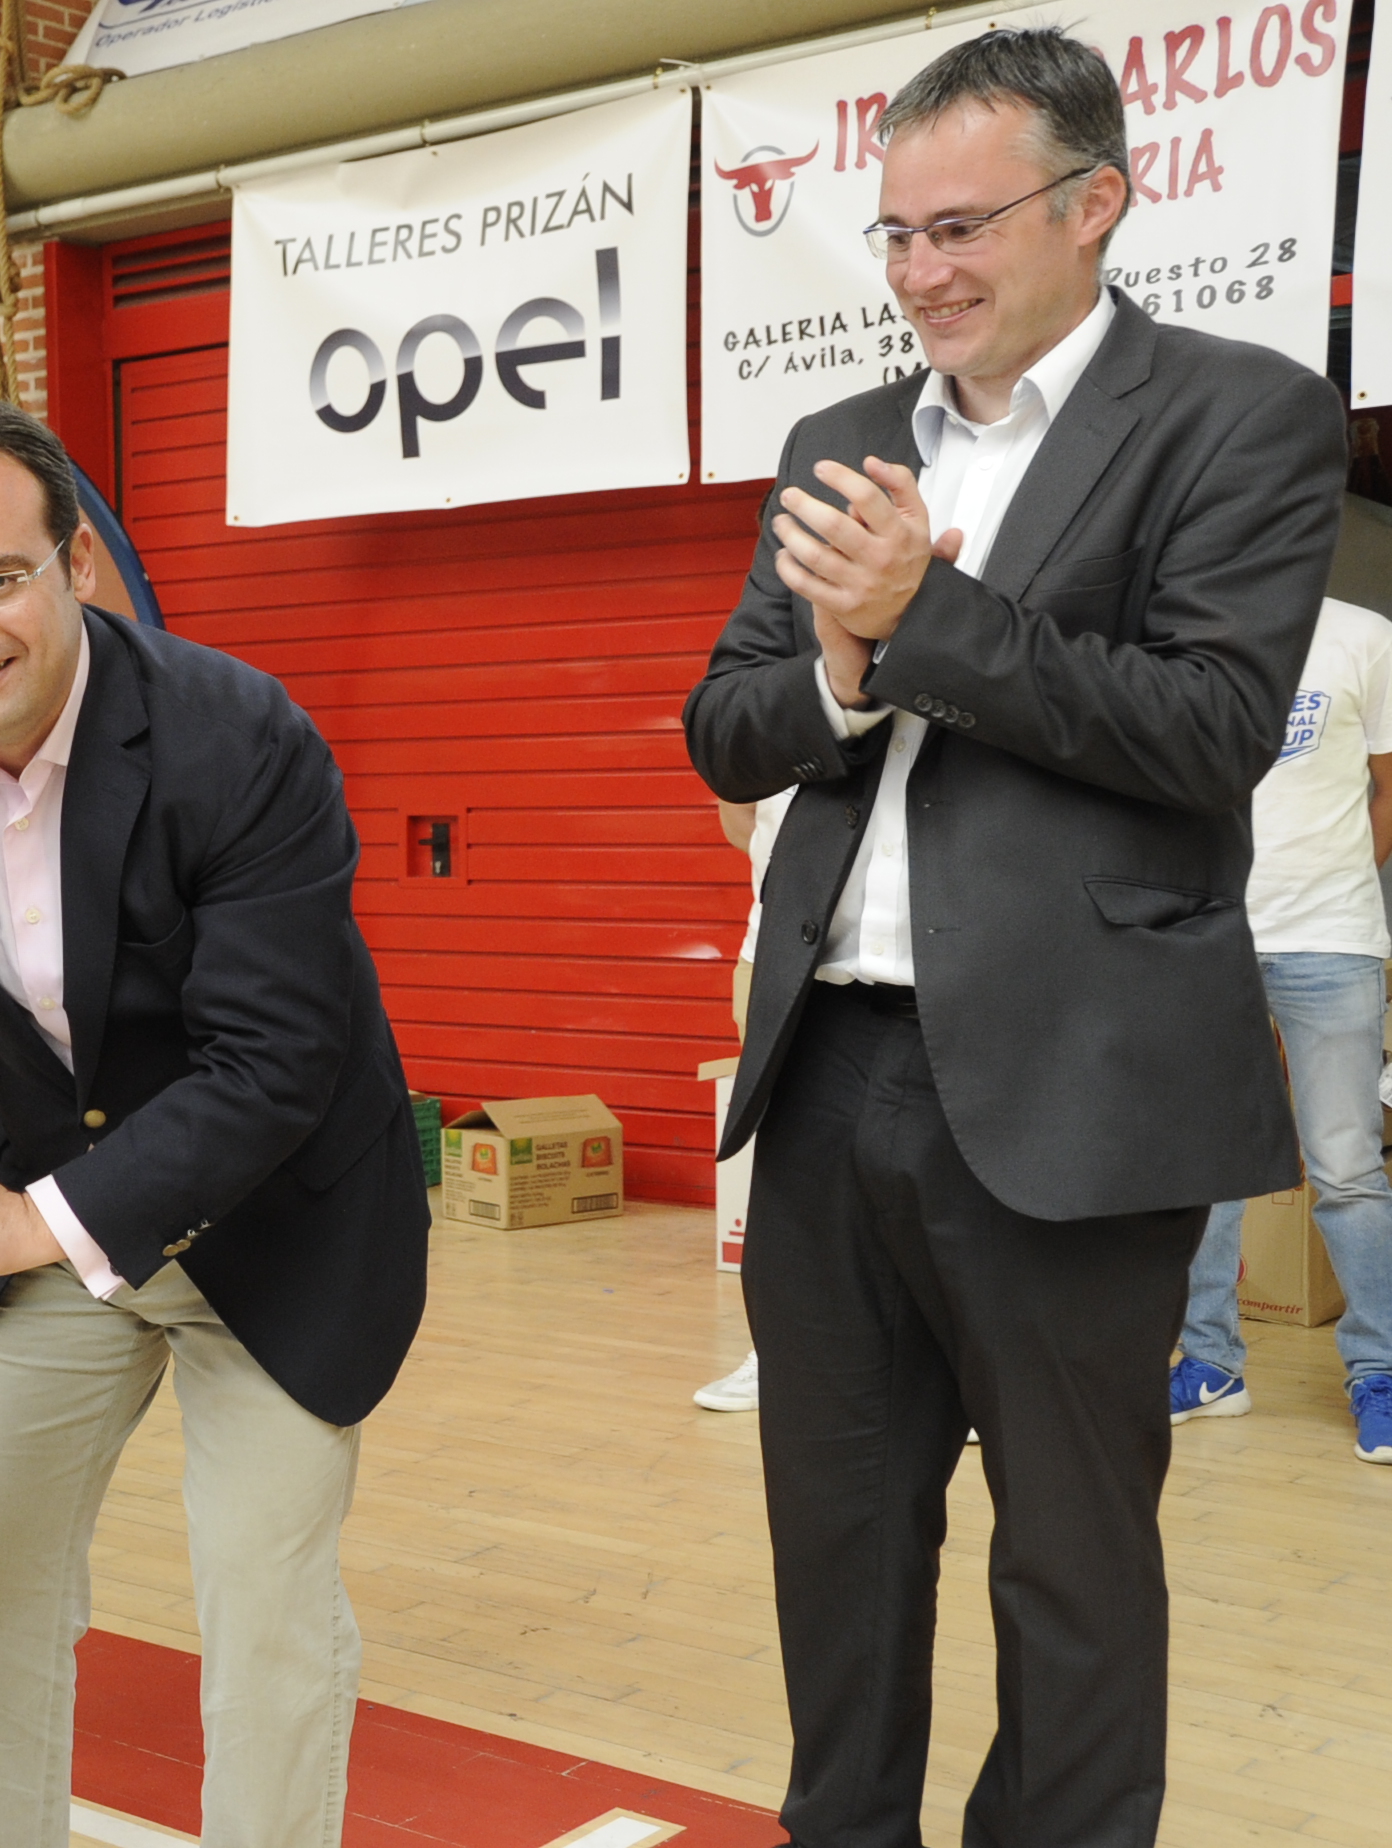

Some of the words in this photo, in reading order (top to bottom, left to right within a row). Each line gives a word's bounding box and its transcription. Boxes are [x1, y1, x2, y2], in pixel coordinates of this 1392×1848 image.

[96, 14, 191, 48] Operador
[1093, 0, 1338, 115] ARLOS
[274, 213, 463, 278] TALLERES
[480, 172, 634, 247] PRIZÁN
[724, 312, 848, 351] GALERIA
[861, 303, 909, 329] LA
[1103, 256, 1228, 288] Puesto
[1246, 237, 1298, 268] 28
[738, 356, 770, 380] C/
[784, 345, 864, 374] Ávila,
[879, 331, 915, 357] 38
[1141, 275, 1274, 316] 61068
[309, 246, 622, 460] opel
